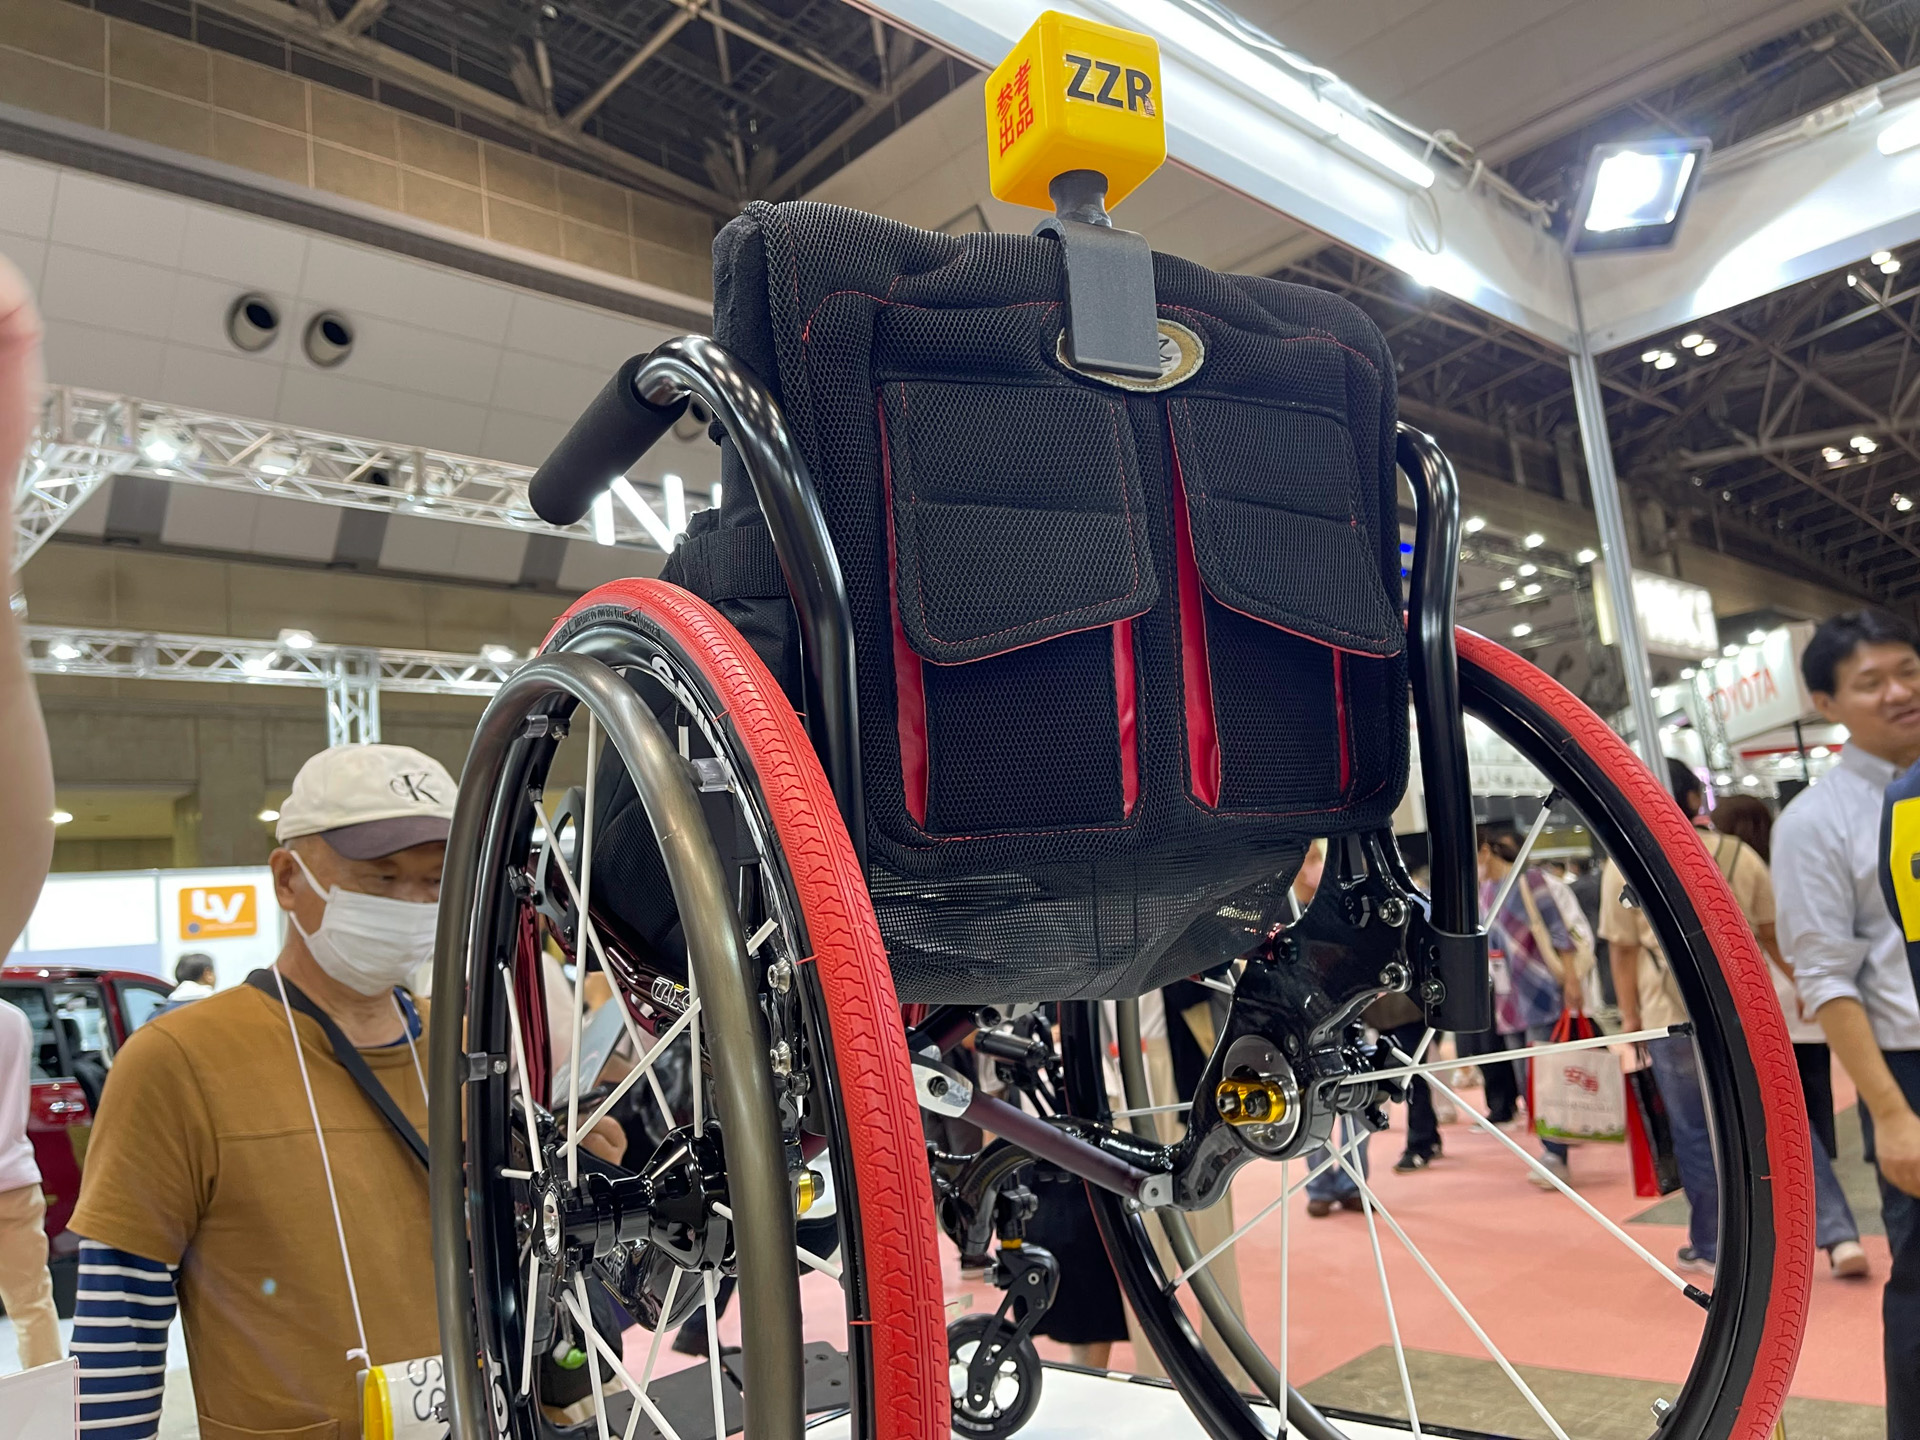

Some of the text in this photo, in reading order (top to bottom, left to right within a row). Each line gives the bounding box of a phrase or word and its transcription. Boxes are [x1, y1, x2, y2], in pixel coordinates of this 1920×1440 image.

[996, 57, 1032, 123] 参考
[1065, 53, 1156, 117] ZZR
[999, 95, 1034, 158] 出品
